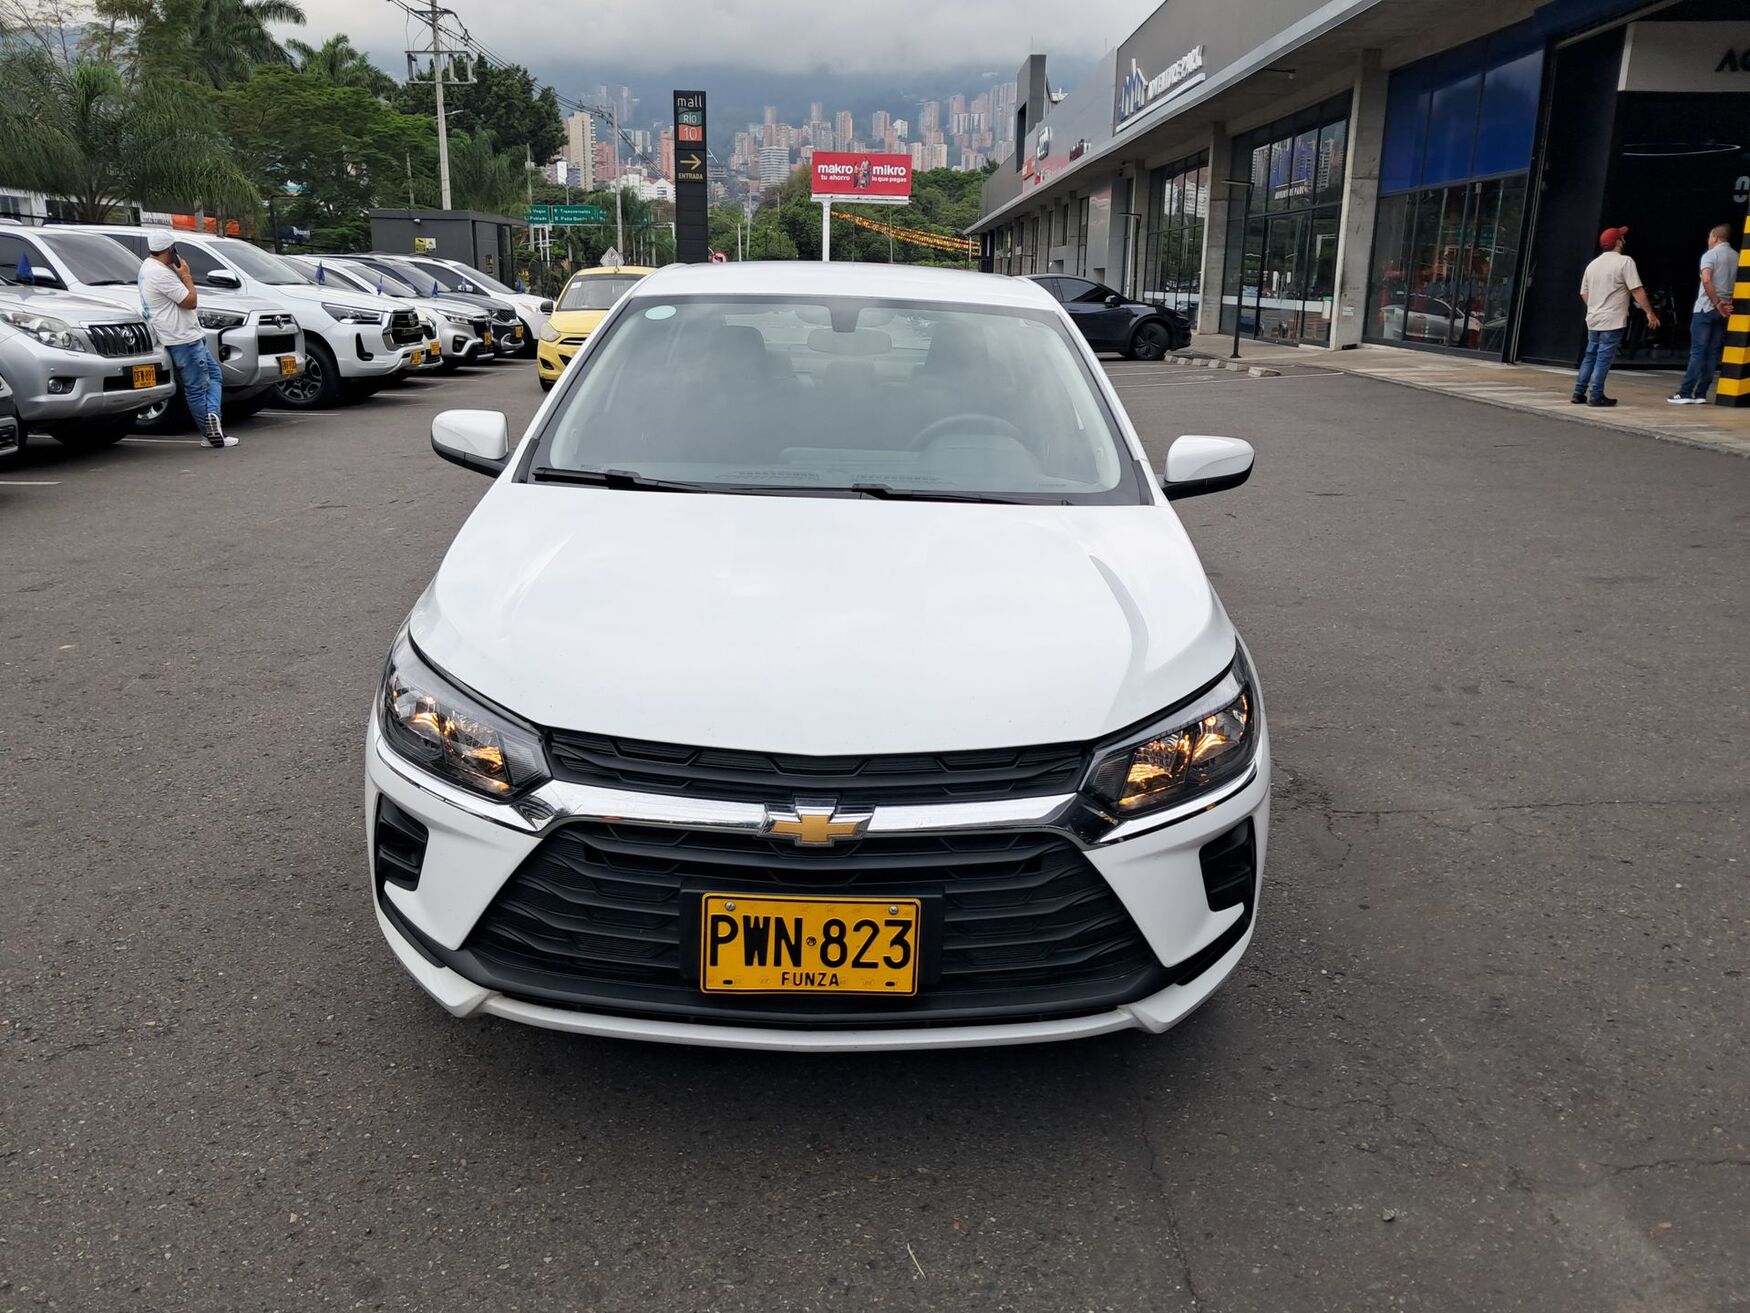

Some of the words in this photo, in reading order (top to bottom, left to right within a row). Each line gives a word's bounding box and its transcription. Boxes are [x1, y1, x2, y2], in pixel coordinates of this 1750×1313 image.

[677, 95, 703, 108] mall
[684, 127, 698, 141] 10
[678, 172, 704, 180] ENTRADA
[817, 163, 854, 175] makro
[872, 164, 906, 176] mikro
[780, 971, 841, 988] FUNZA
